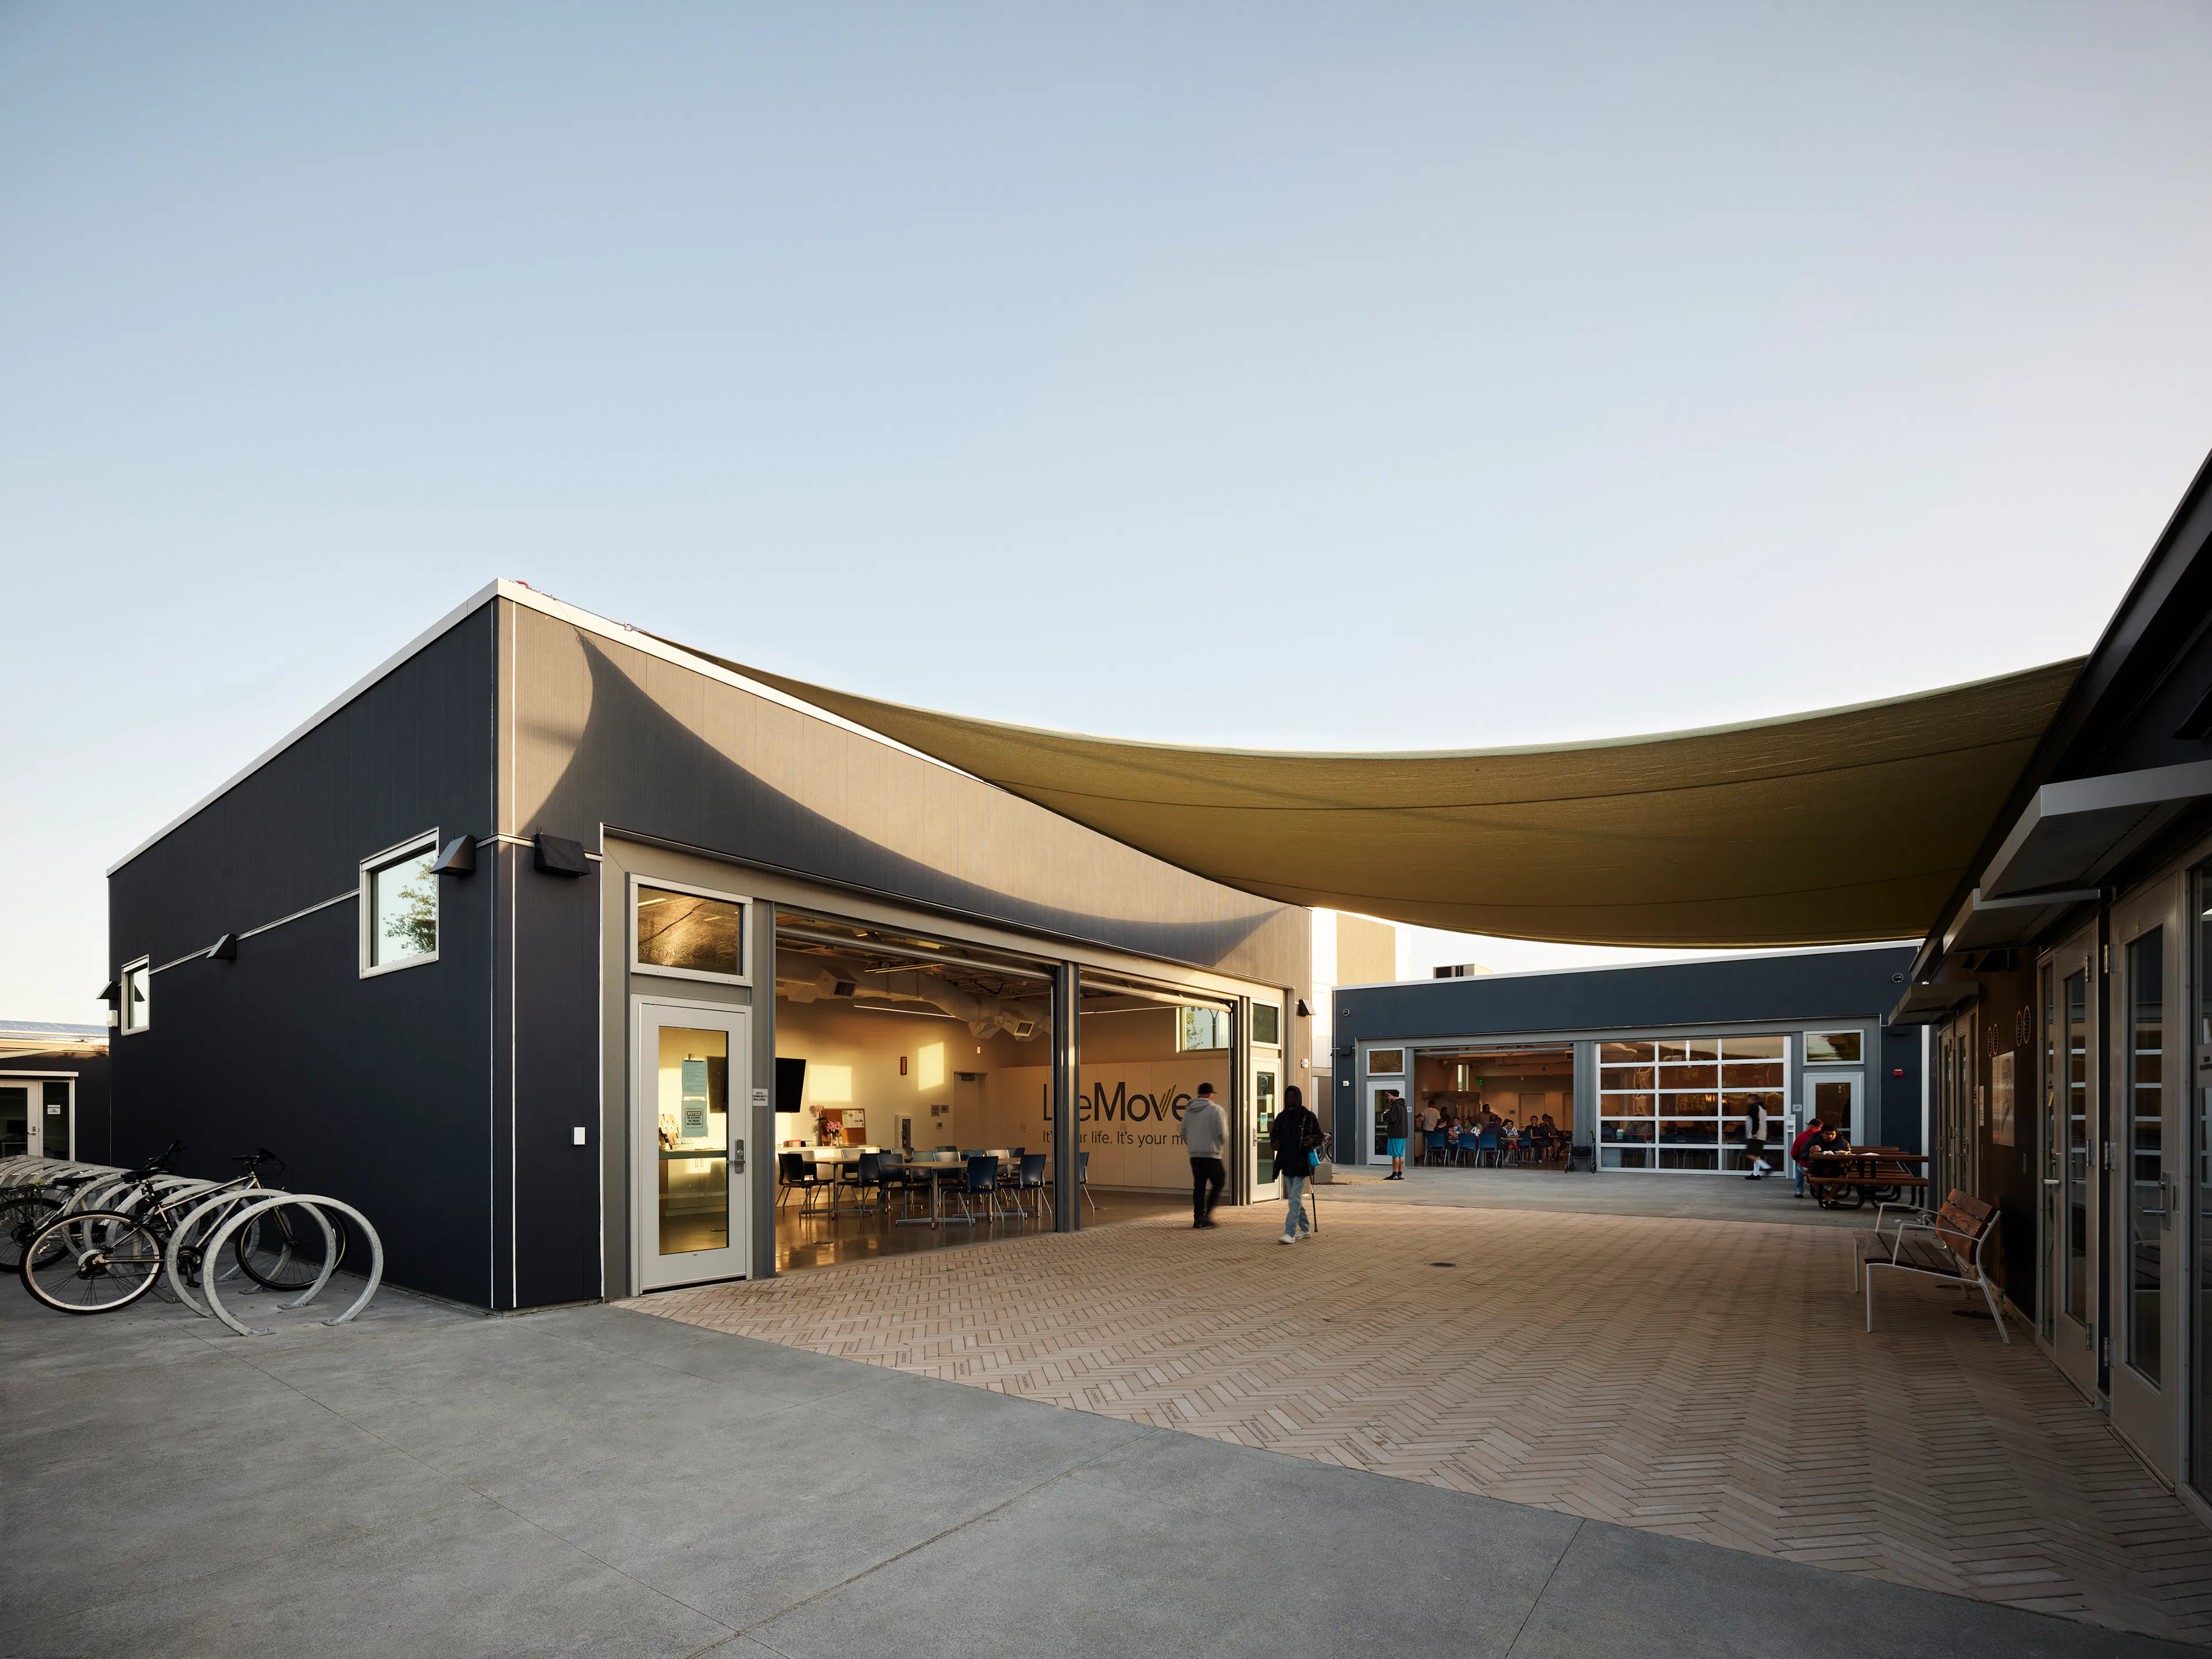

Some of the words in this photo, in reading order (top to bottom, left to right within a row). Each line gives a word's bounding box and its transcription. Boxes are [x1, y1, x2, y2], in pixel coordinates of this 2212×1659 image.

[1044, 1082, 1192, 1122] LeMove
[1043, 1130, 1052, 1142] It'
[1092, 1131, 1112, 1144] life.
[1118, 1131, 1133, 1145] It's
[1138, 1135, 1168, 1147] your
